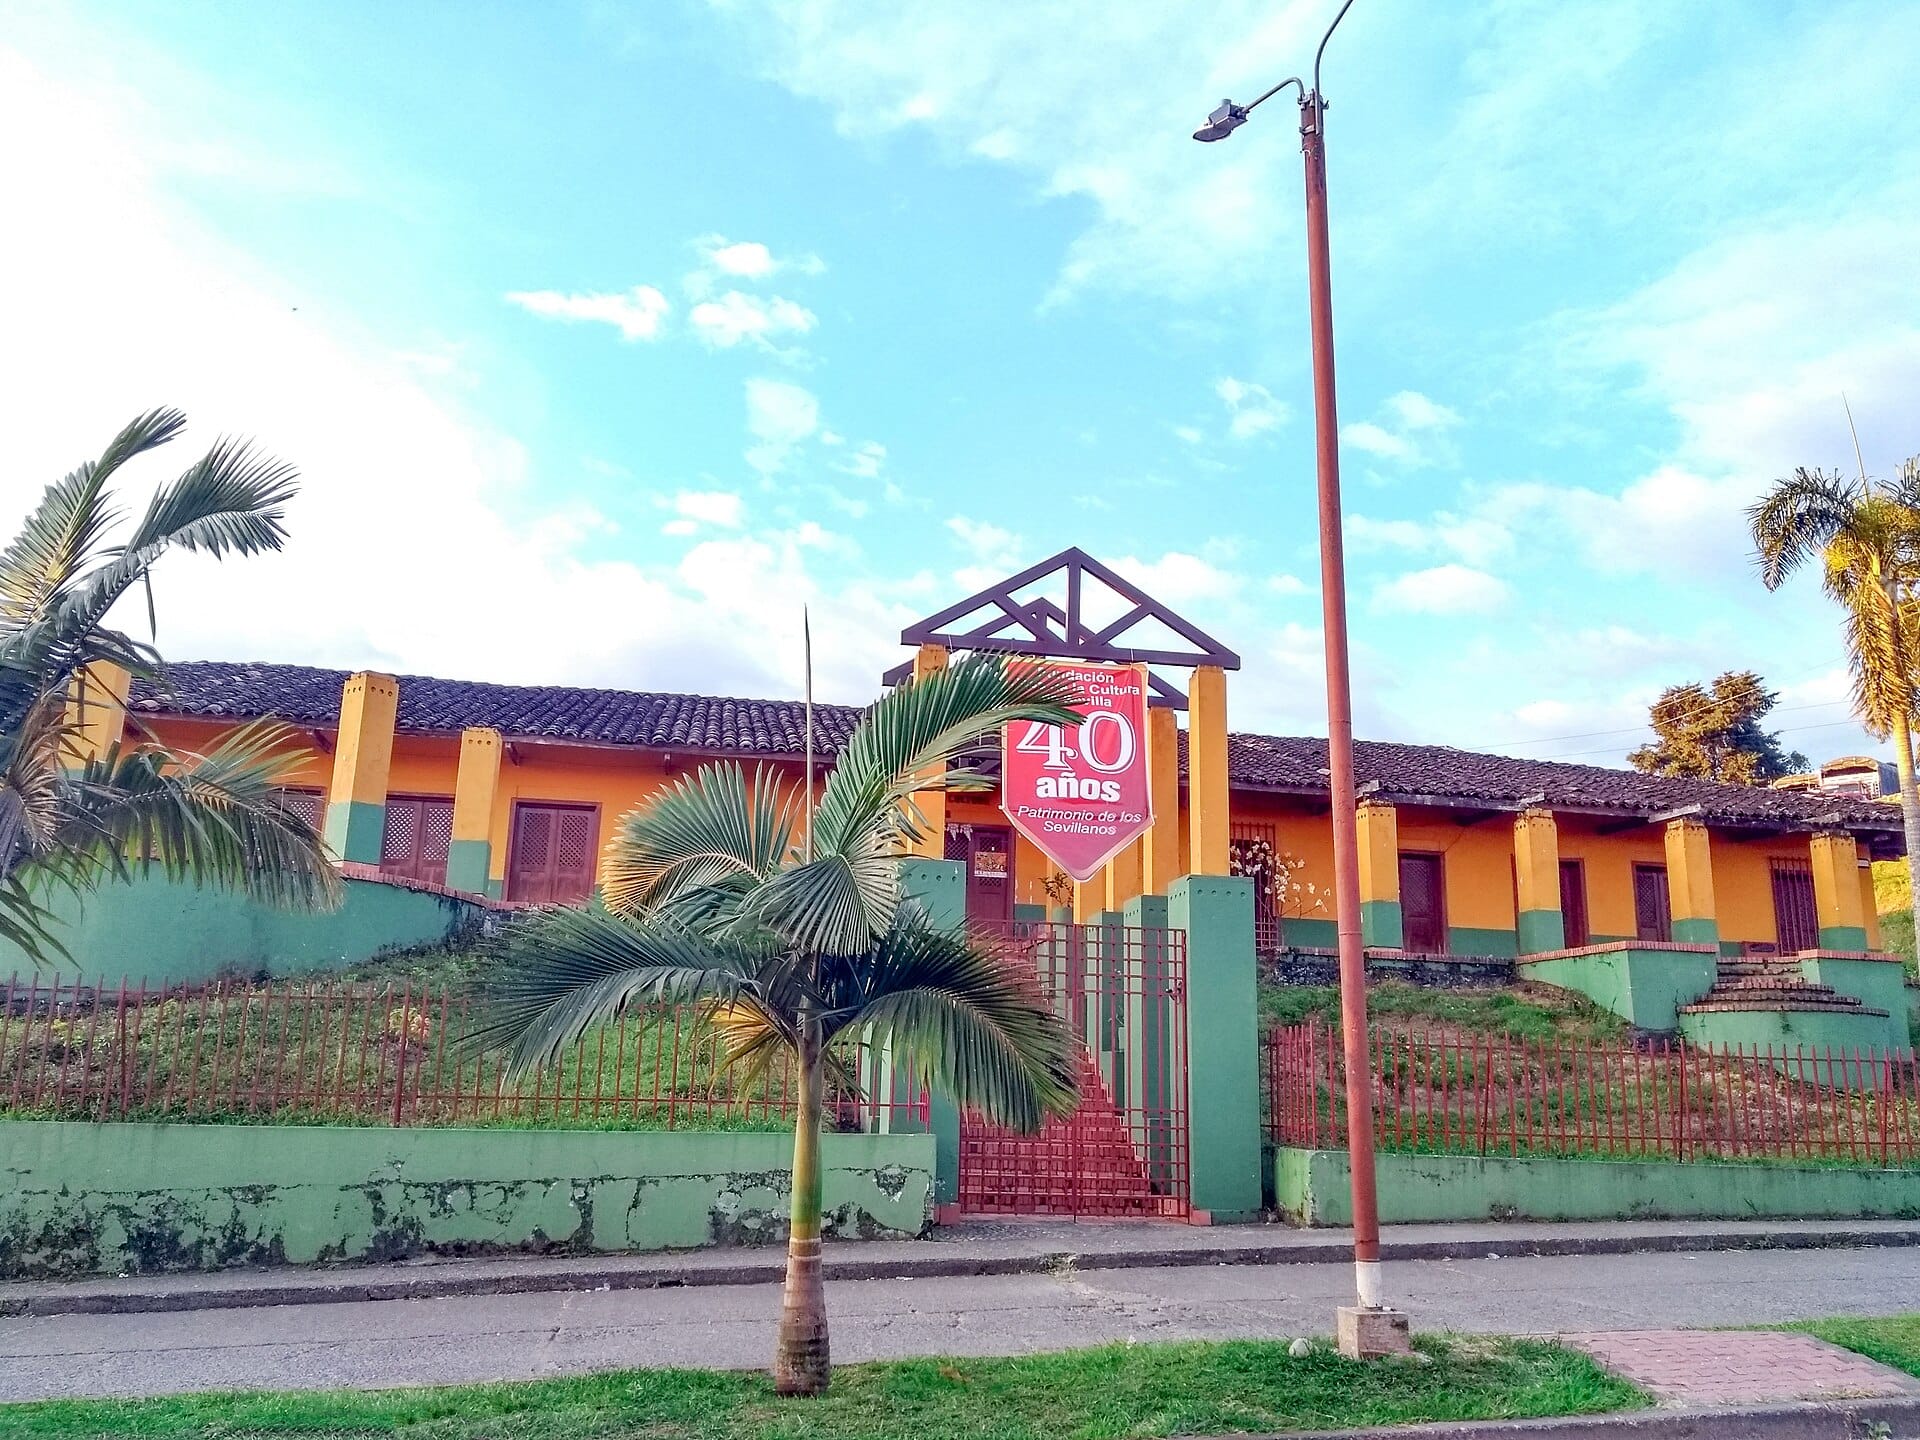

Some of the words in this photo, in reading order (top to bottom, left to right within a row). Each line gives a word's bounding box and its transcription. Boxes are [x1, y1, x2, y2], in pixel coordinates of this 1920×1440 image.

[1089, 684, 1140, 696] Cultura
[1016, 711, 1136, 774] 40
[1035, 771, 1121, 802] años
[1017, 805, 1094, 821] Patrimonio
[1098, 810, 1116, 822] de
[1120, 811, 1142, 823] los
[1043, 820, 1117, 835] Sevillanos
